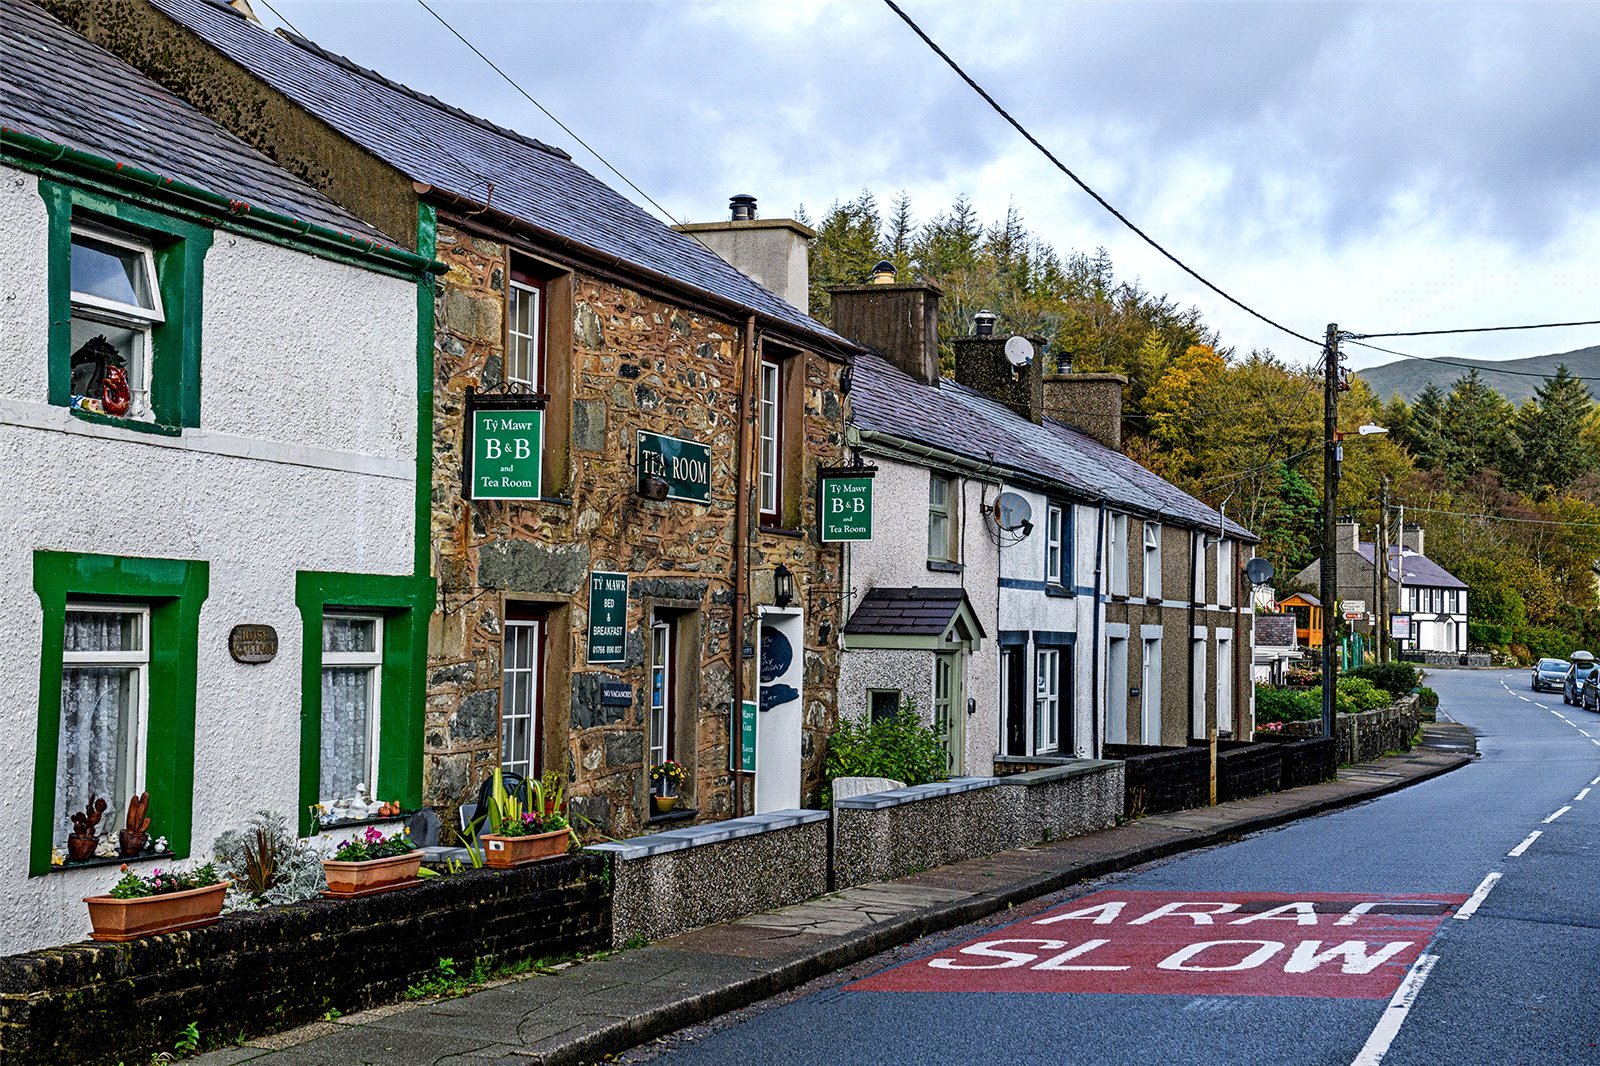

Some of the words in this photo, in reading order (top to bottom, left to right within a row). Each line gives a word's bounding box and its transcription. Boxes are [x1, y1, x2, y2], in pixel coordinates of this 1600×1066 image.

[501, 418, 533, 431] Mawr
[485, 438, 502, 459] B
[504, 443, 513, 453] &
[513, 438, 531, 459] B
[500, 464, 514, 472] and
[642, 449, 667, 477] TEA
[672, 456, 707, 485] ROOM
[481, 476, 499, 488] Tea
[502, 476, 532, 488] Room
[843, 484, 867, 493] Mawr
[831, 497, 844, 513] B
[845, 501, 852, 509] &
[852, 497, 865, 513] B
[829, 525, 842, 533] Tea
[843, 525, 867, 533] Room
[605, 579, 626, 591] MAWR
[603, 598, 615, 608] BED
[606, 612, 611, 622] &
[593, 626, 623, 636] BREAKFAST
[603, 690, 610, 698] NO
[610, 690, 632, 699] VACANCIES
[927, 938, 1415, 975] SLOW
